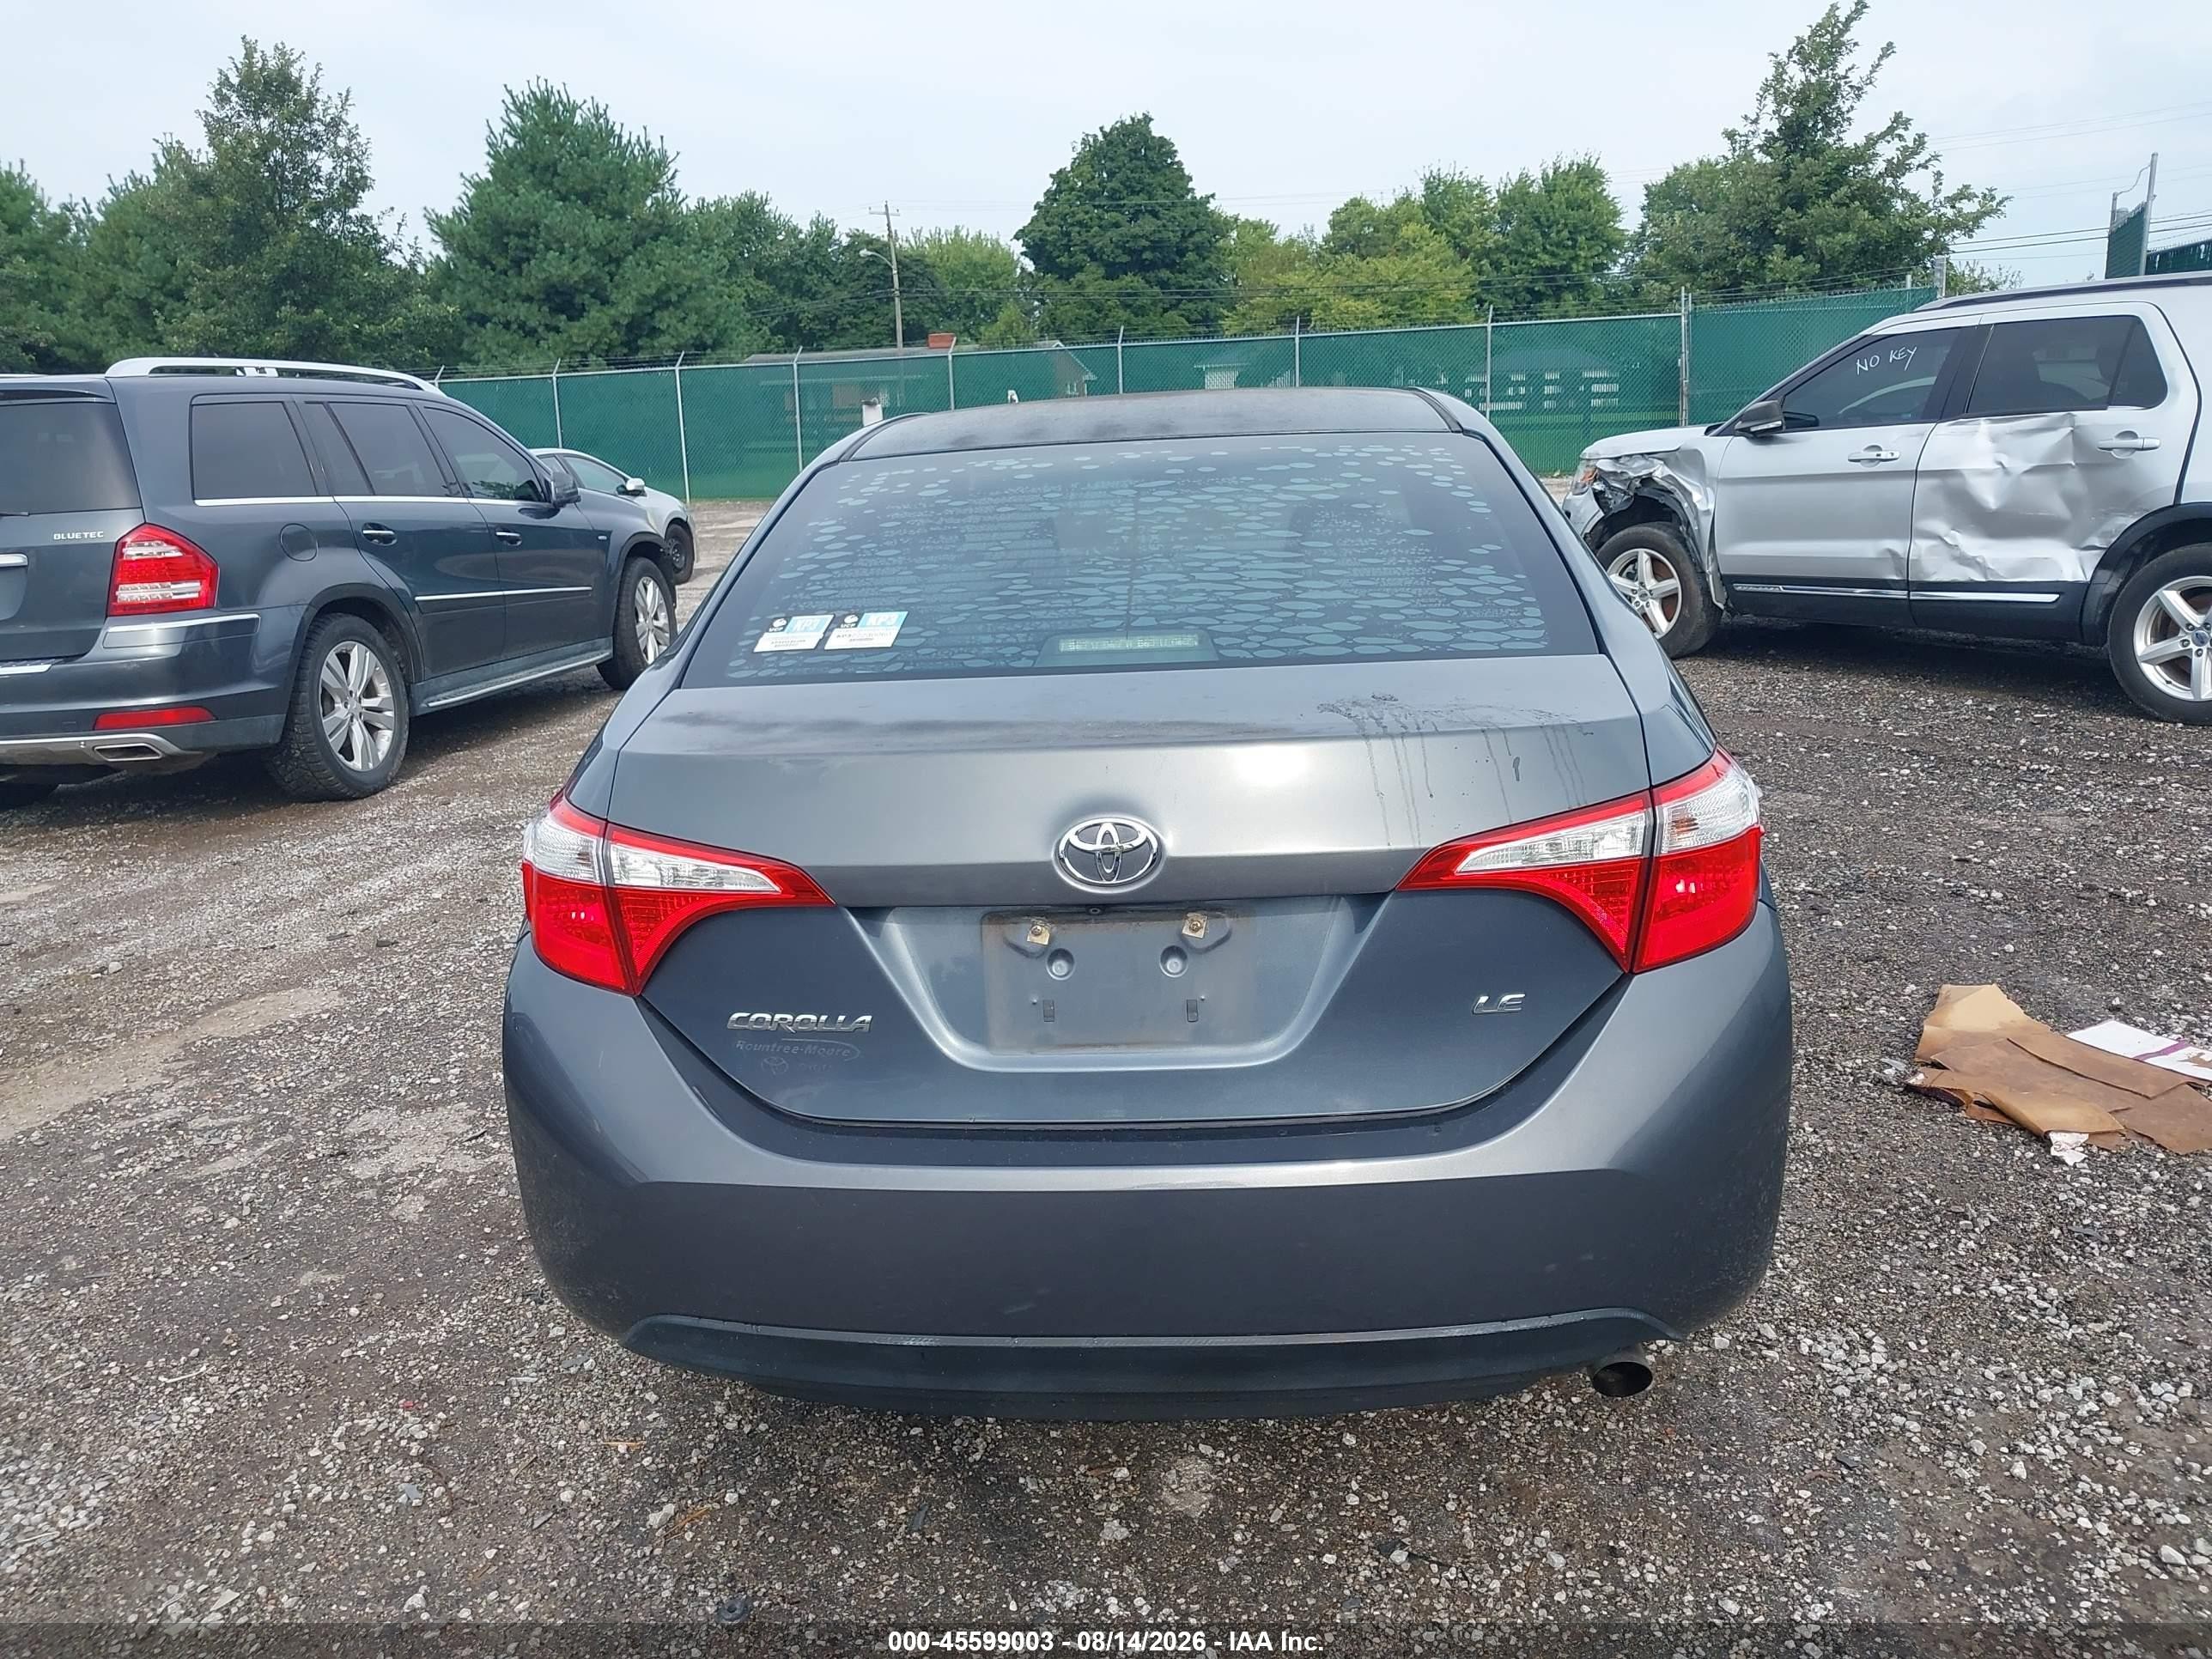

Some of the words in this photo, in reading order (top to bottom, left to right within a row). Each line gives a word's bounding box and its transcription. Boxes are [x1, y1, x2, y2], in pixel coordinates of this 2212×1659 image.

[1856, 355, 1880, 375] NO
[1889, 346, 1917, 371] KEY
[53, 531, 104, 540] BLUETEC
[1473, 994, 1526, 1014] LE
[727, 1012, 873, 1033] COROLLA
